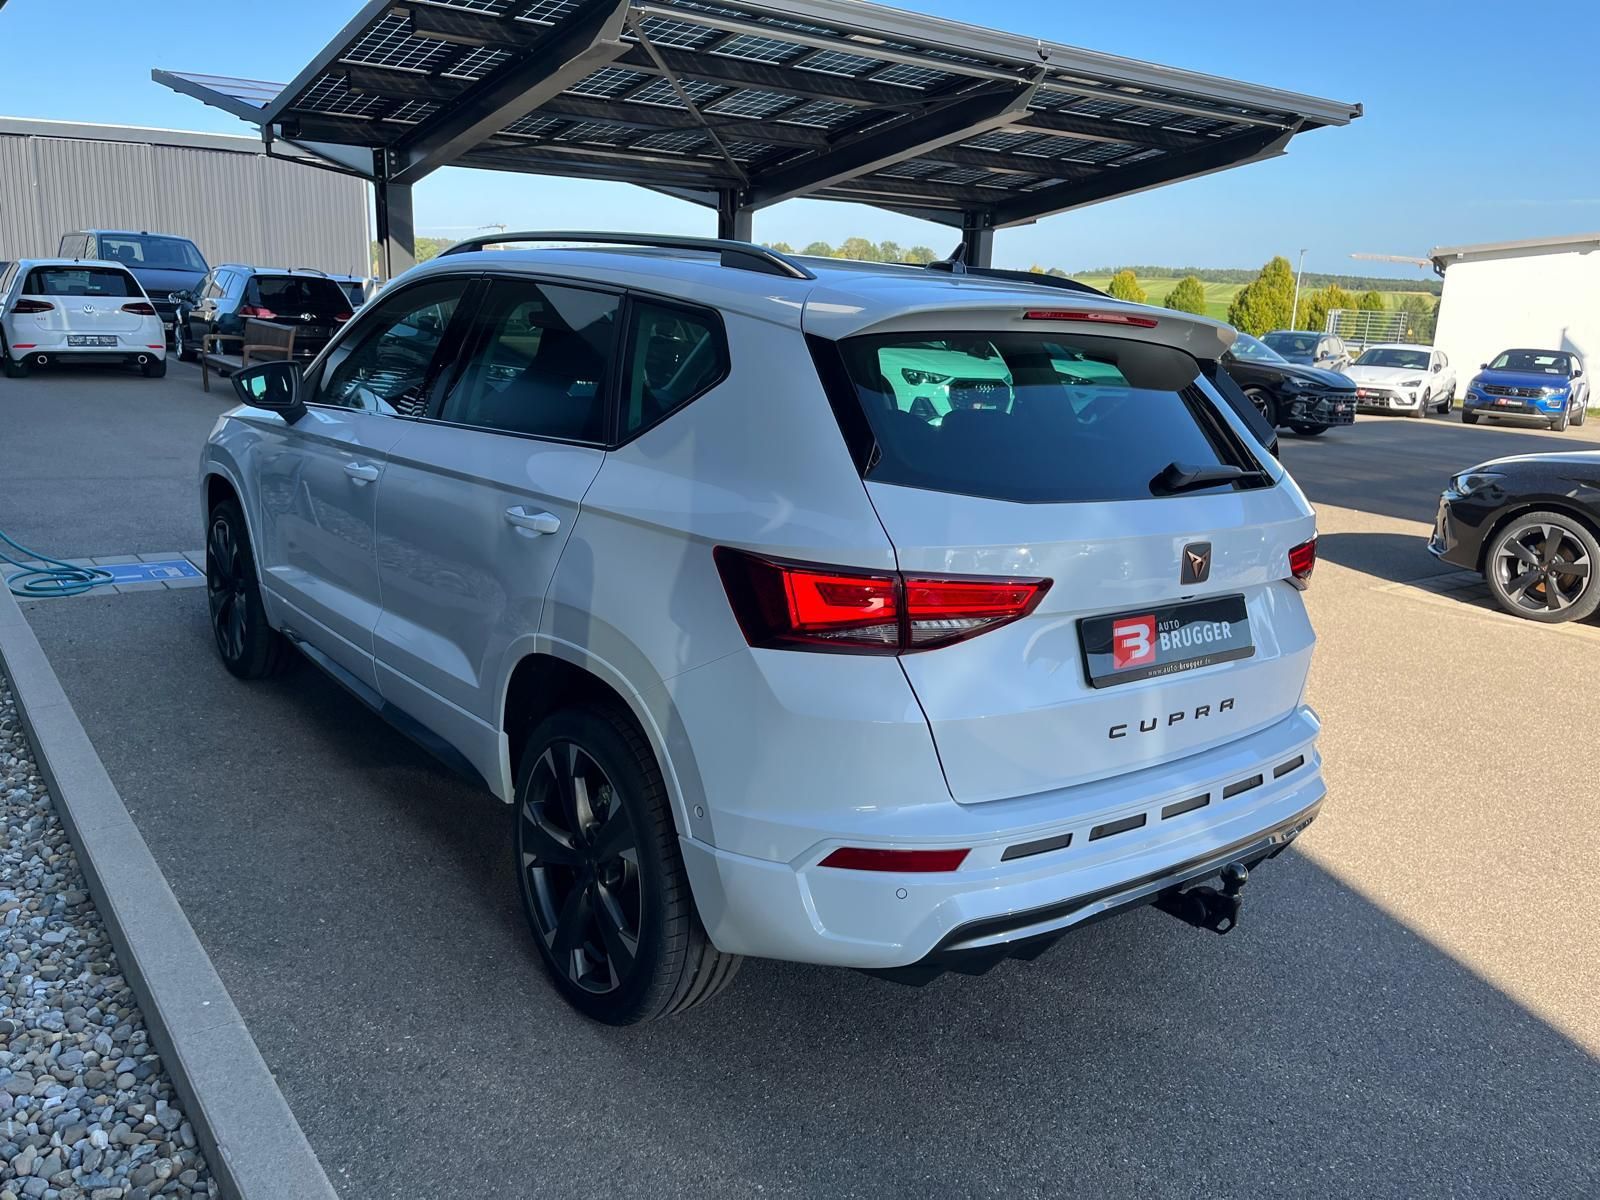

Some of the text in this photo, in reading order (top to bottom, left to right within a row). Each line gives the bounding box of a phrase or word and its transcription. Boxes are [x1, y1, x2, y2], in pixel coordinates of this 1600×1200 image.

[1158, 619, 1180, 631] AUTO
[1160, 621, 1233, 651] BRUGGER
[1148, 658, 1211, 676] www.autobruggerde
[1108, 697, 1235, 739] CUPRA
